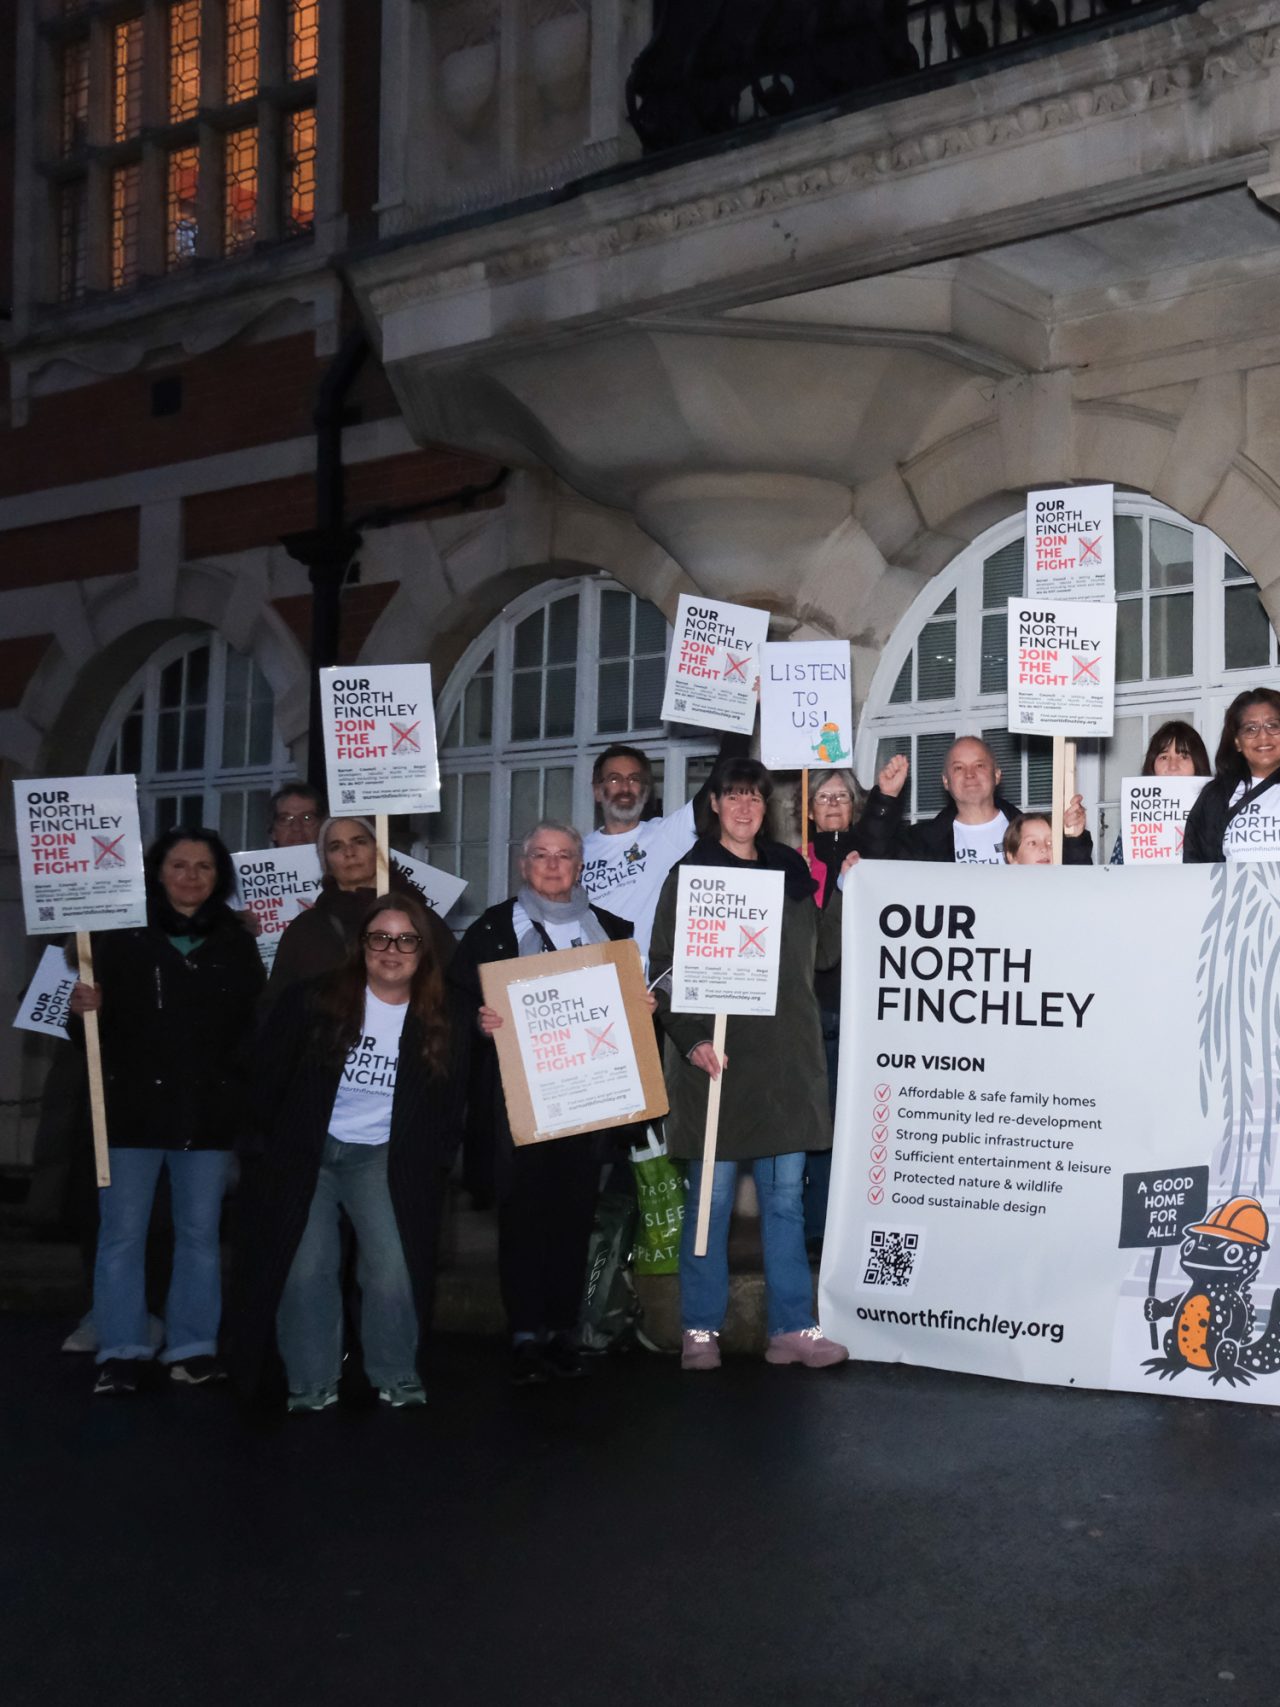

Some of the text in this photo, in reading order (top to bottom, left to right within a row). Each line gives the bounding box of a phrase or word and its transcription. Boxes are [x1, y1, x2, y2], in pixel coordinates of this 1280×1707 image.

[1035, 500, 1064, 512] OUR
[1035, 510, 1082, 524] NORTH
[1035, 520, 1101, 535] FINCHLEY
[1036, 536, 1067, 548] JOIN
[1036, 548, 1062, 559] THE
[1036, 559, 1076, 571] FIGHT
[687, 606, 718, 621] OUR
[1019, 611, 1056, 623] OUR
[686, 617, 735, 636] NORTH
[1019, 624, 1077, 637] NORTH
[684, 629, 752, 652] FINCHLEY
[1019, 637, 1100, 650] FINCHLEY
[681, 640, 715, 656] JOIN
[1019, 649, 1058, 661] JOIN
[680, 651, 708, 666] THE
[678, 662, 720, 680] FIGHT
[771, 664, 846, 680] LISTEN
[1019, 661, 1051, 673] THE
[332, 679, 369, 691] OUR
[1019, 674, 1068, 686] FIGHT
[333, 692, 393, 705] NORTH
[792, 691, 818, 707] TO
[335, 704, 417, 718] FINCHLEY
[335, 720, 375, 732] JOIN
[792, 711, 827, 727] US!
[336, 734, 369, 745] THE
[337, 746, 387, 759] FIGHT
[27, 791, 69, 804] OUR
[1130, 787, 1162, 798] OUR
[29, 804, 95, 818] NORTH
[1130, 799, 1180, 810] NORTH
[31, 816, 122, 832] FINCHLEY
[1130, 823, 1162, 834] JOIN
[31, 833, 76, 846] JOIN
[1131, 836, 1157, 846] THE
[32, 848, 69, 861] THE
[1132, 846, 1171, 859] FIGHT
[34, 860, 89, 875] FIGHT
[240, 861, 275, 875] OUR
[242, 871, 298, 888] NORTH
[690, 879, 726, 891] OUR
[690, 892, 746, 906] NORTH
[689, 906, 768, 920] FINCHLEY
[687, 919, 726, 931] JOIN
[879, 904, 976, 939] OUR
[687, 932, 718, 944] THE
[686, 946, 735, 958] FIGHT
[880, 946, 1031, 983] NORTH
[44, 980, 72, 1025] NORTH
[522, 989, 559, 1006] OUR
[30, 993, 52, 1021] OUR
[525, 997, 584, 1020] NORTH
[878, 987, 1095, 1028] FINCHLEY
[528, 1006, 609, 1033] FINCHLEY
[530, 1028, 571, 1046] JOIN
[534, 1043, 567, 1060] THE
[536, 1053, 586, 1073] FIGHT
[876, 1053, 985, 1072] OUR VISION
[898, 1087, 1096, 1107] Affordable & safe family homes
[897, 1108, 1102, 1130] Community led re-development
[896, 1129, 1074, 1150] Strong public infrastructure
[895, 1150, 1111, 1174] Sufficient entertainment & leisure
[894, 1172, 1063, 1193] Protected nature & wildlife
[1137, 1177, 1193, 1194] A GOOD
[892, 1193, 1046, 1216] Good sustainable design
[1145, 1193, 1185, 1208] HOME
[1150, 1209, 1177, 1223] FOR
[1147, 1224, 1176, 1238] ALL!
[857, 1307, 1064, 1343] ournorthfinchley.org
